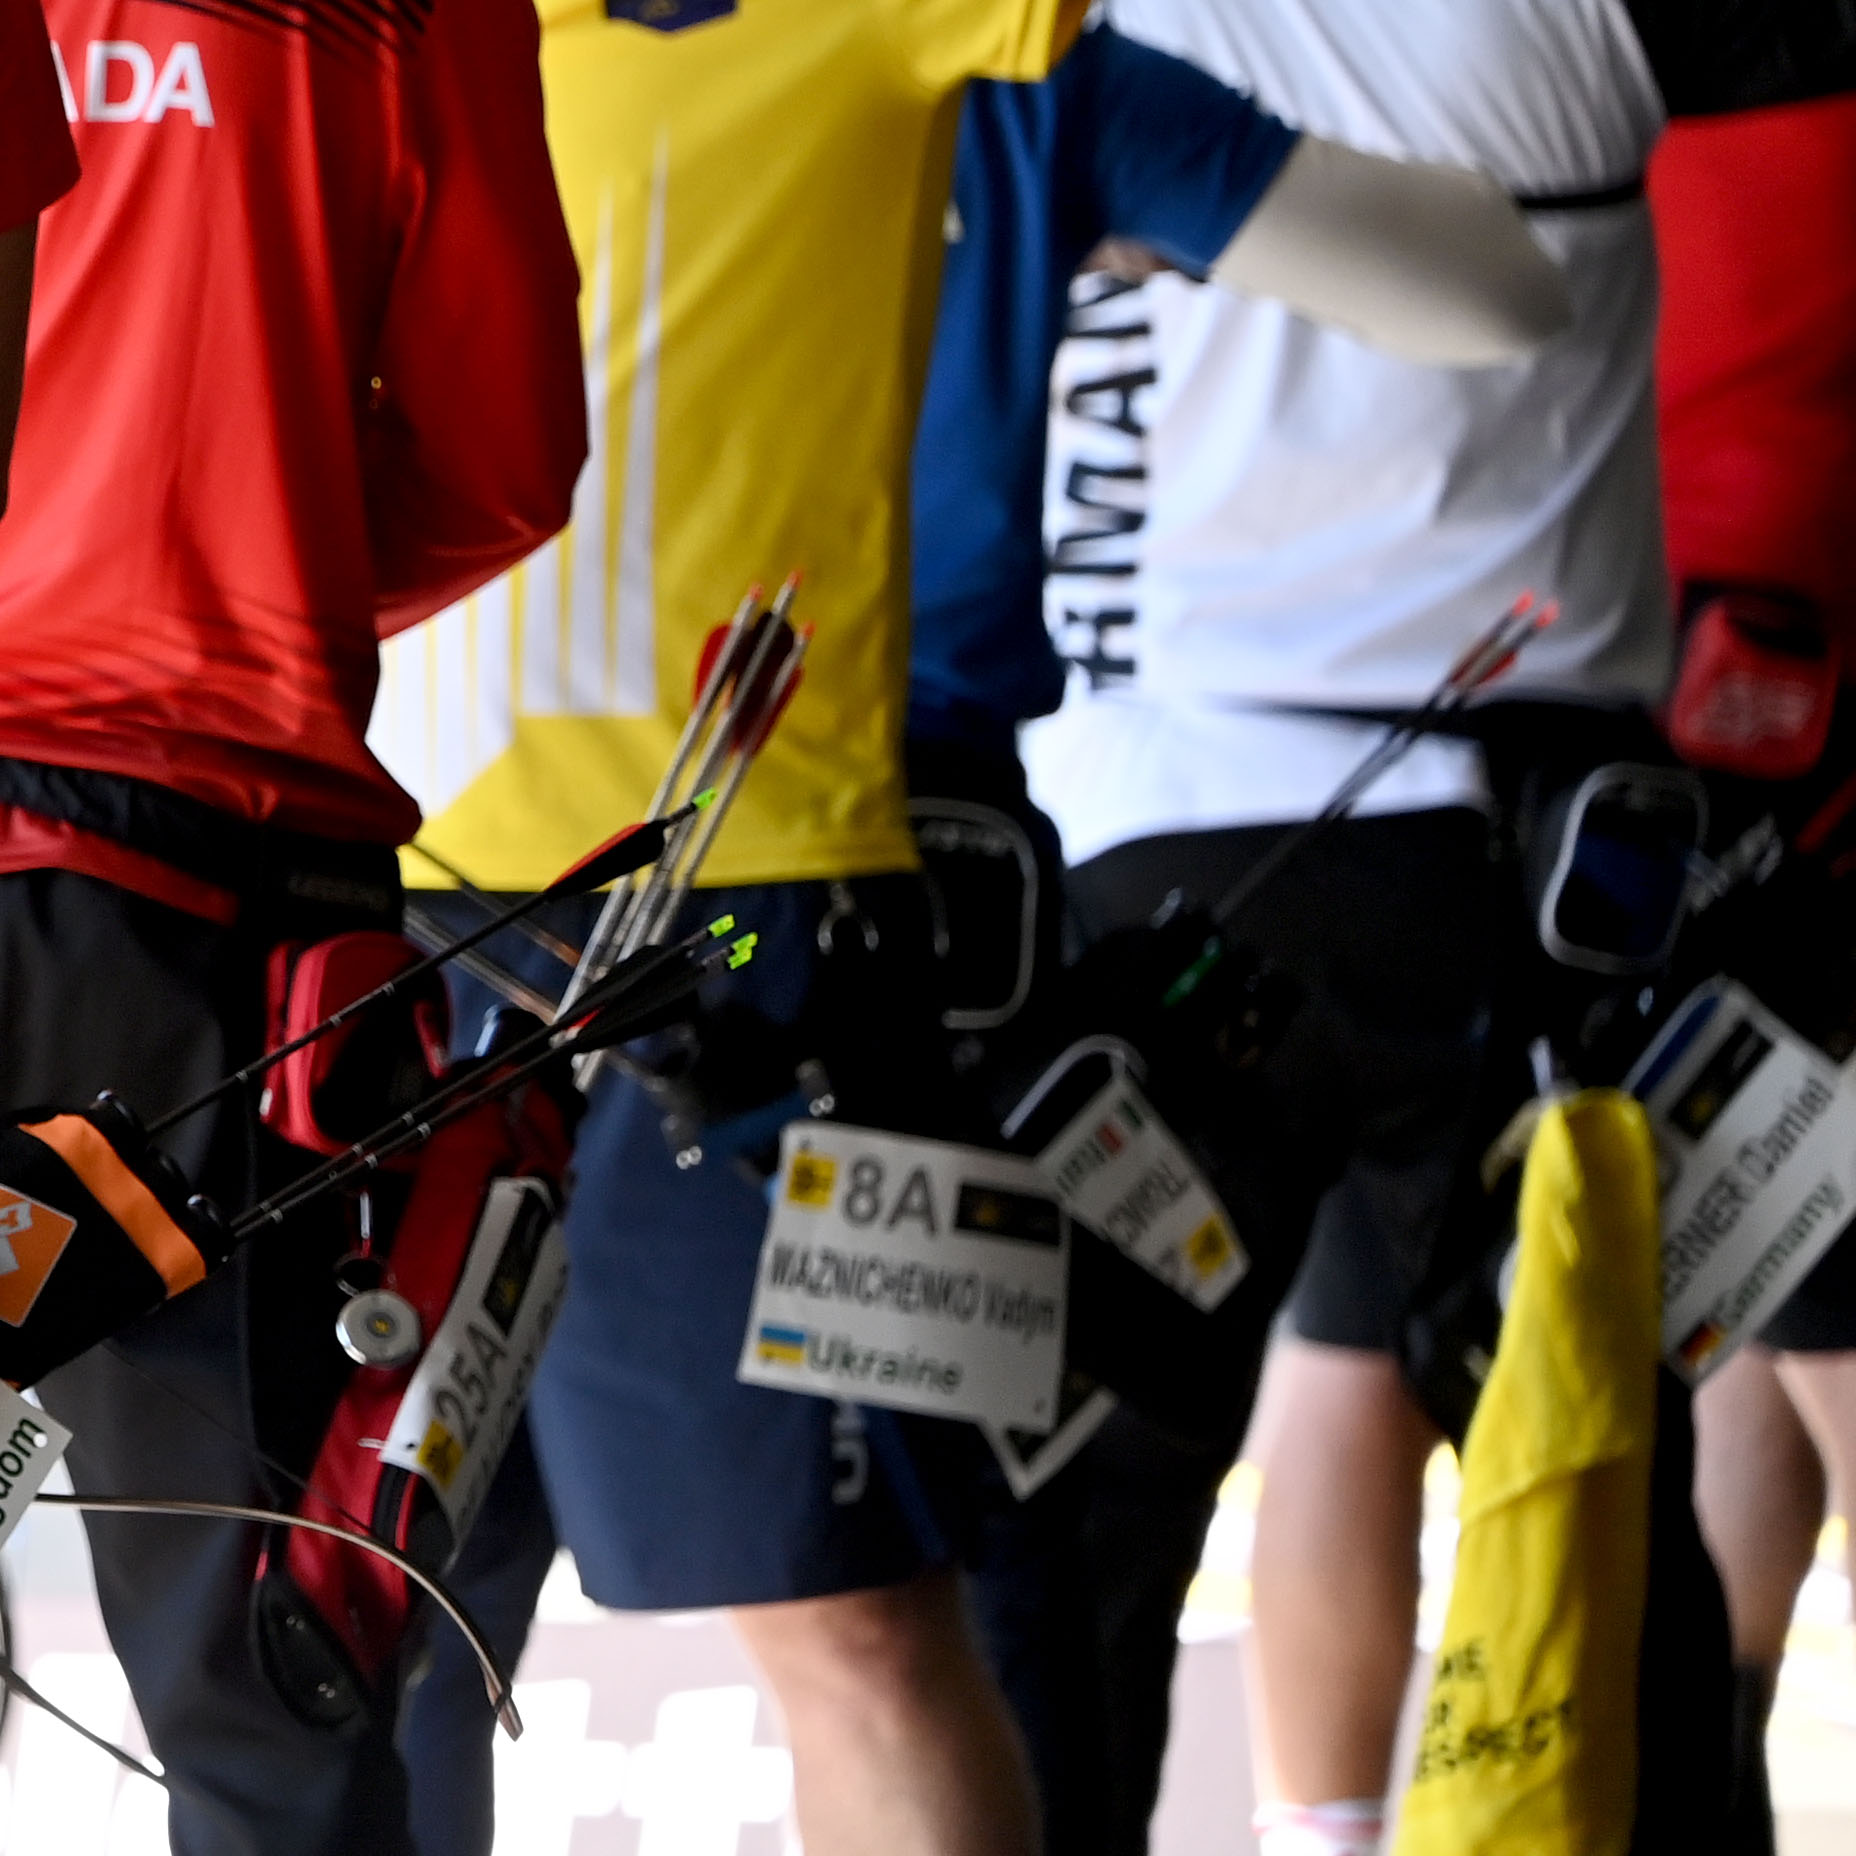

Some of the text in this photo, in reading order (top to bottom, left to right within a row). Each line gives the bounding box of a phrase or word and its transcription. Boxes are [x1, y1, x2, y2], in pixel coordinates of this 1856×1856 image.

[843, 1155, 938, 1237] 8A
[434, 1320, 510, 1444] 25A
[806, 1334, 963, 1396] Ukraine
